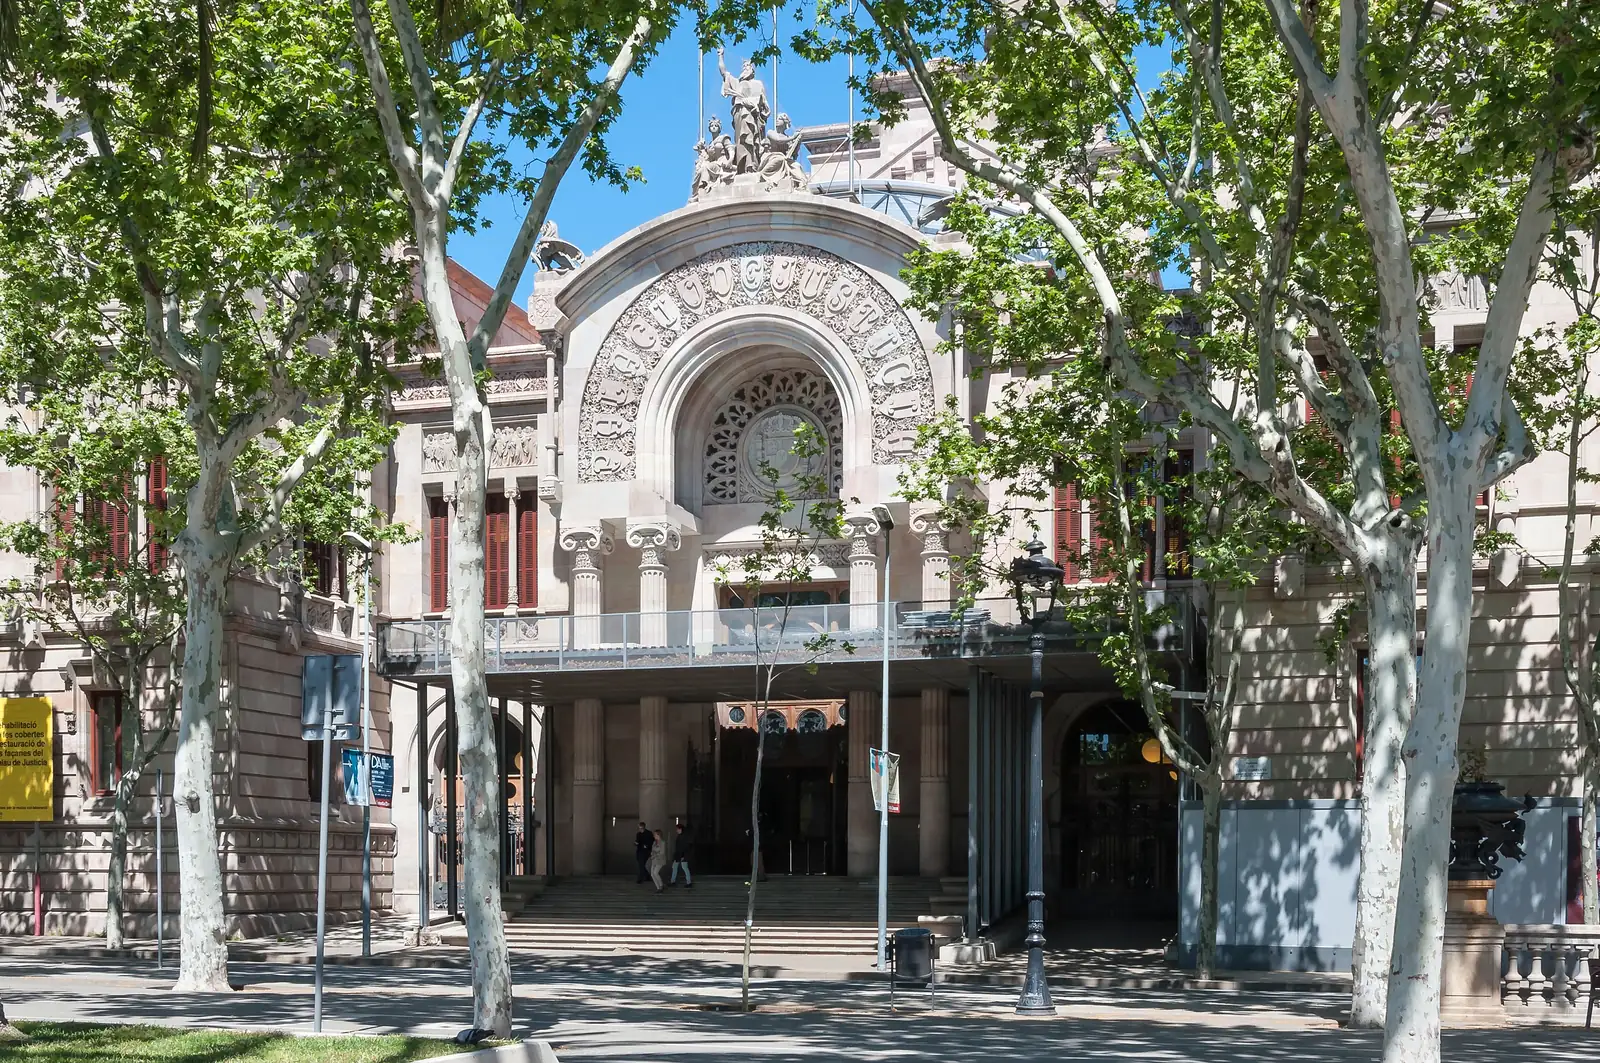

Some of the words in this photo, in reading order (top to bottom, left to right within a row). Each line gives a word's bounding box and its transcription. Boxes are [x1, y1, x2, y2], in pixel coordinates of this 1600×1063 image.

[0, 720, 37, 729] habilitació
[15, 730, 45, 738] cobertes
[5, 749, 31, 759] façanes
